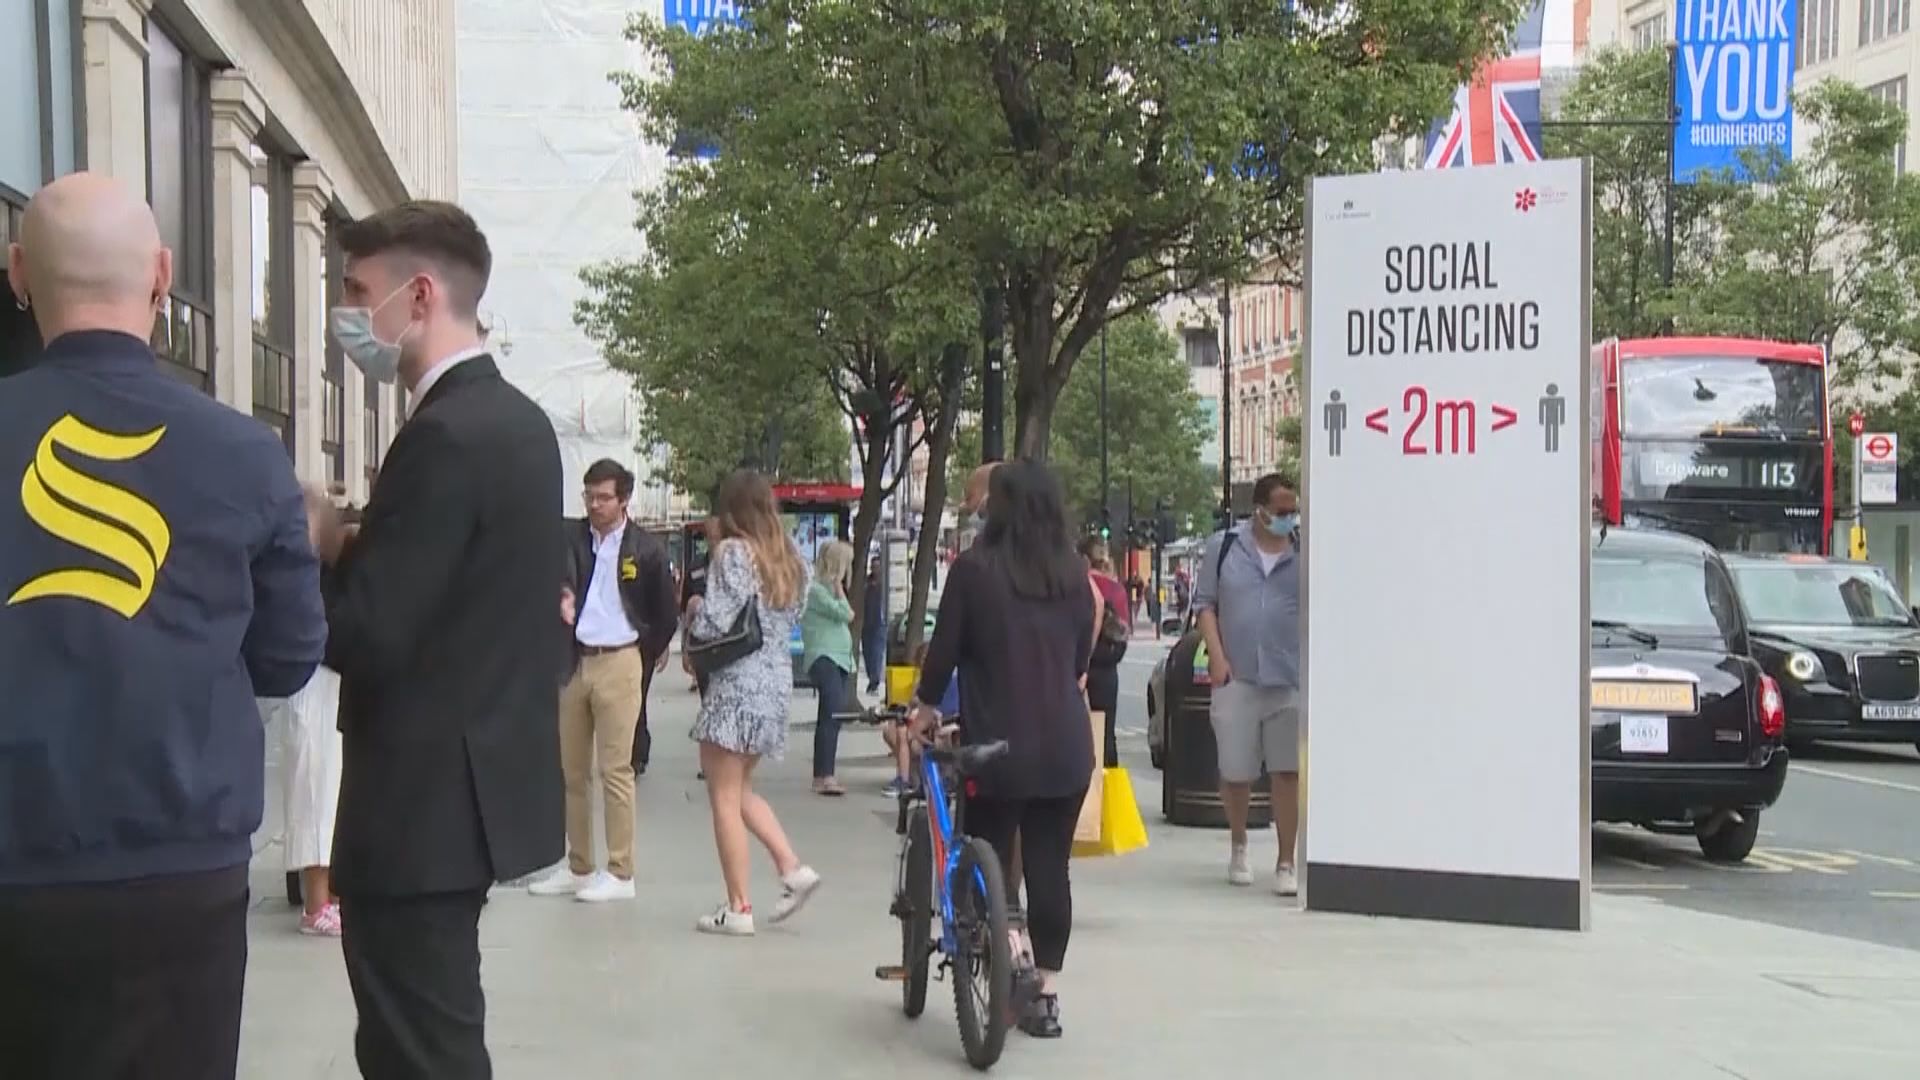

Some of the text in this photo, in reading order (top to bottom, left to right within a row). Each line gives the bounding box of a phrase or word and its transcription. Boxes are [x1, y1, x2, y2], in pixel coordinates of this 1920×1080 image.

[1683, 0, 1789, 41] THANK
[1683, 42, 1790, 121] YOU
[1690, 122, 1786, 147] #OURHEROES
[1385, 241, 1498, 293] SOCIAL
[1347, 301, 1540, 357] DISTANCING
[1655, 459, 1795, 487] Edgware 113
